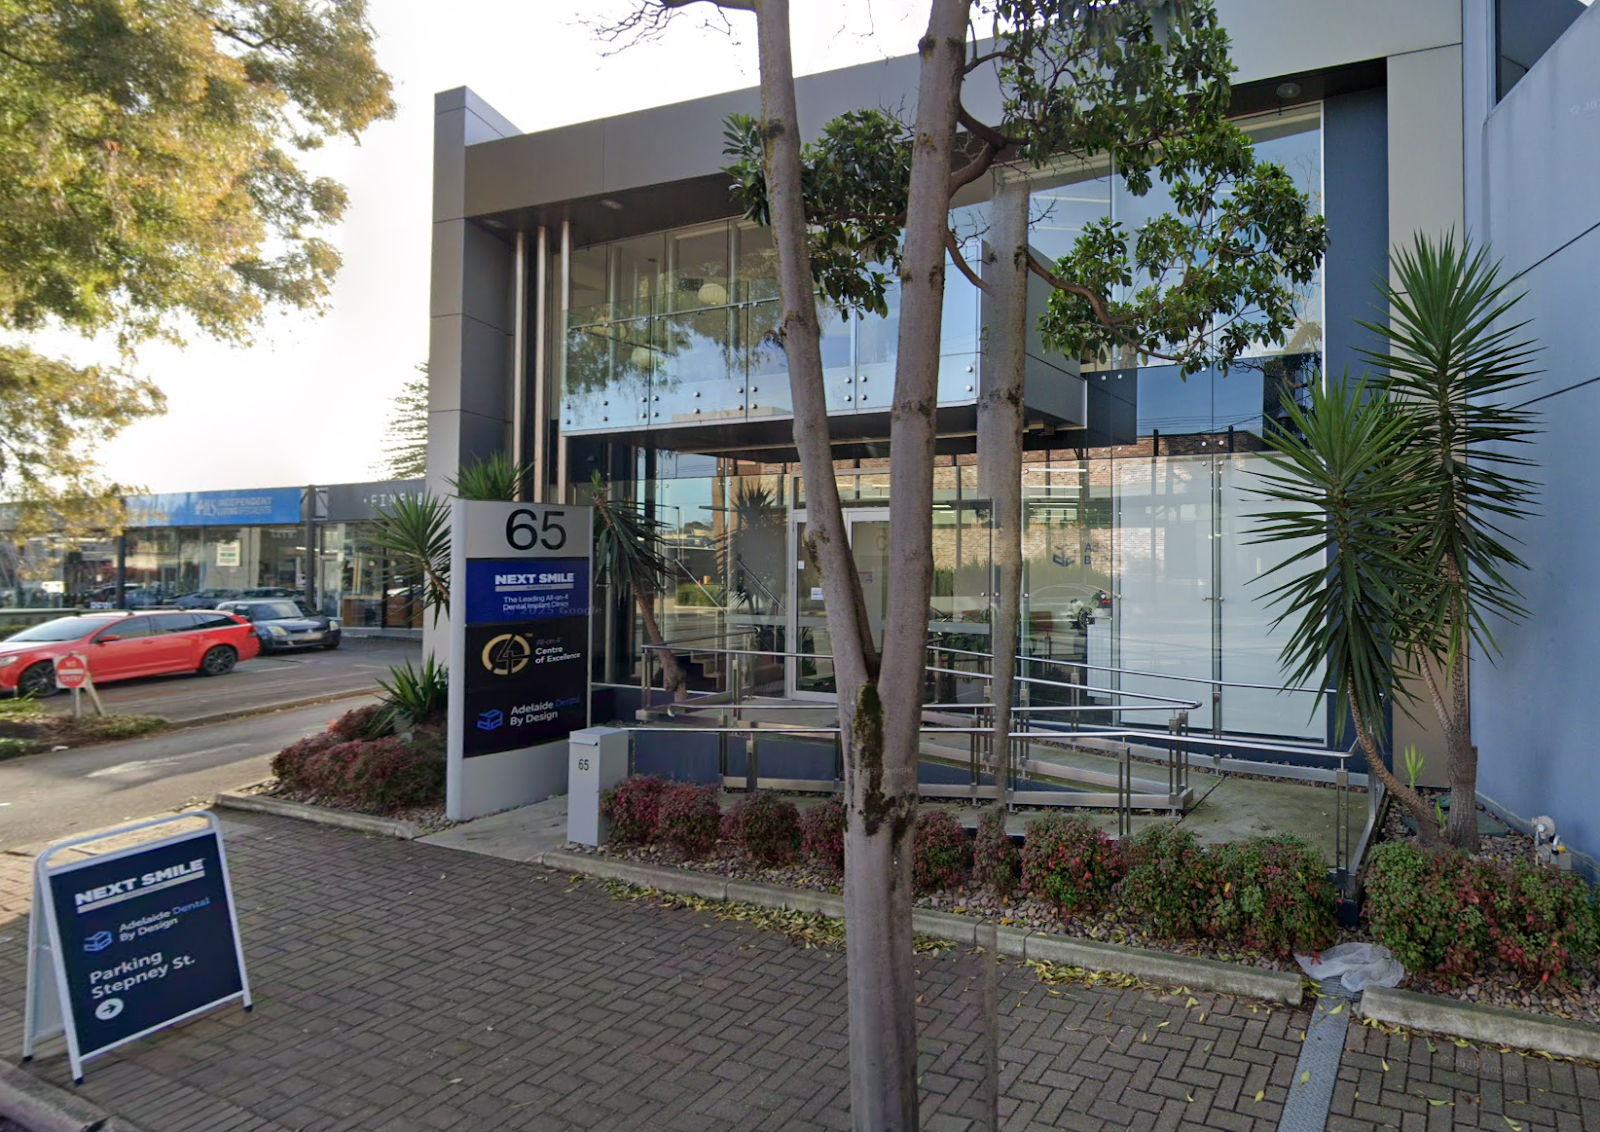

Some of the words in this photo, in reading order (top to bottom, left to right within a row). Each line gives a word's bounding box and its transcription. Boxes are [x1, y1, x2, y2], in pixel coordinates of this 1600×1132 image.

[506, 508, 567, 550] 65
[494, 574, 536, 585] NEXT
[538, 573, 574, 583] SMILE
[502, 602, 527, 610] Dental
[519, 595, 545, 603] Leading
[535, 646, 563, 655] Centre
[535, 656, 545, 664] of
[546, 652, 581, 663] Excellence
[511, 701, 554, 715] Adelaide
[510, 716, 524, 727] By
[525, 711, 558, 723] Design
[578, 758, 589, 771] 65
[74, 877, 138, 906] NEXT
[140, 858, 205, 887] SMILE
[118, 909, 171, 932] Adelaide
[172, 897, 210, 915] Dental
[119, 931, 136, 943] By
[137, 916, 179, 937] Design
[90, 951, 163, 984] Parking
[91, 961, 169, 999] Stepney
[172, 954, 196, 971] St.
